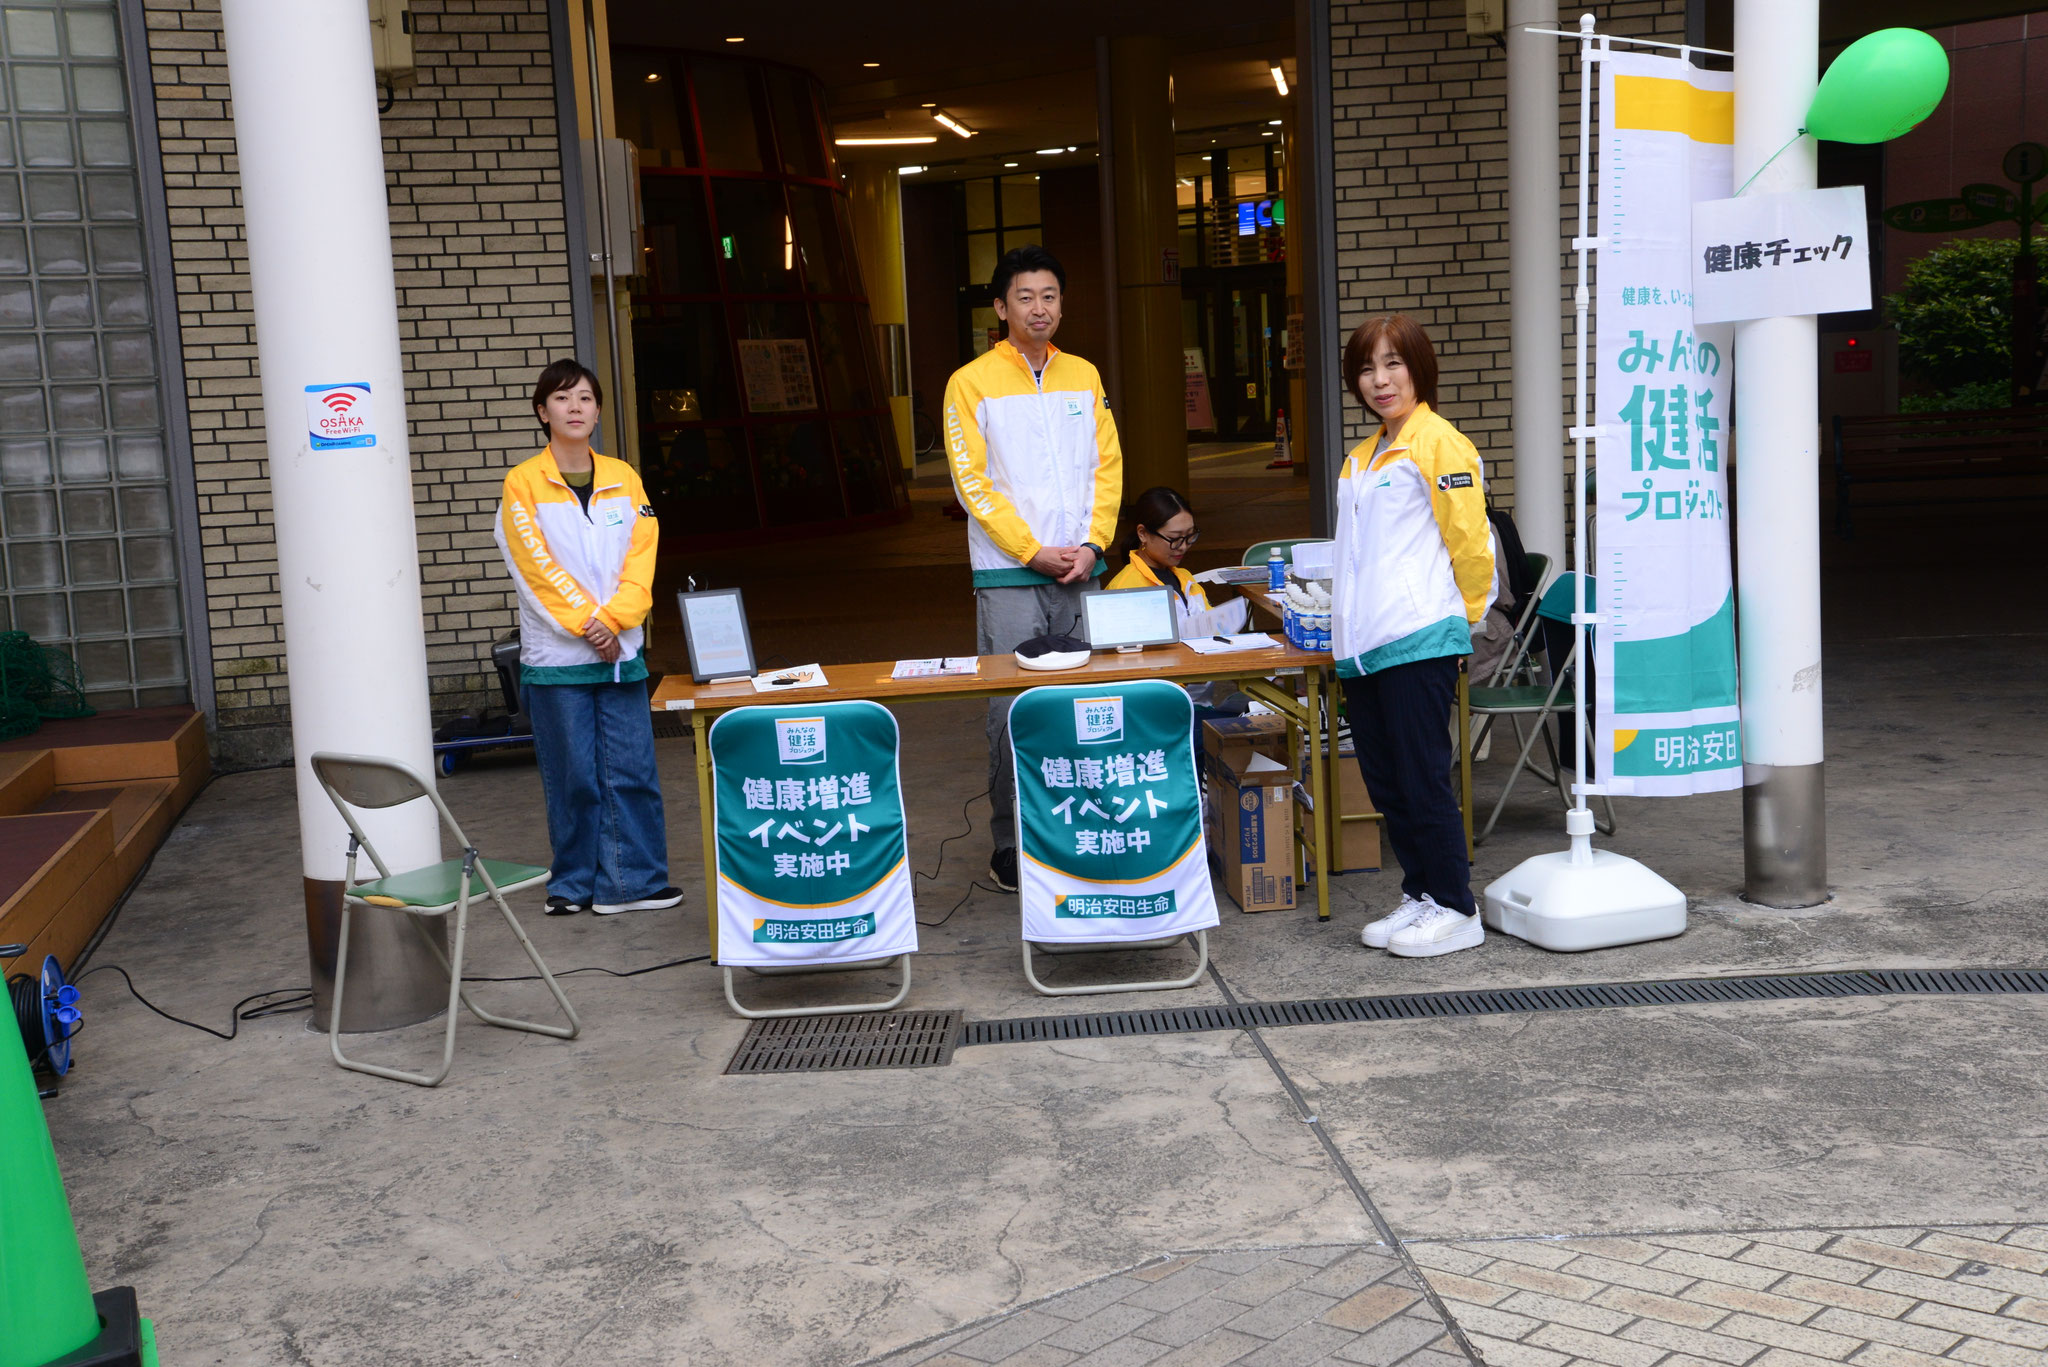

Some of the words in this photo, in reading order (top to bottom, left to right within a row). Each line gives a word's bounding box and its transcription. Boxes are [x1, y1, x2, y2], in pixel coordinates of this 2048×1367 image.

[1703, 234, 1854, 274] 健康チェック
[320, 414, 364, 428] OSAKA
[1618, 384, 1720, 472] 健活
[1622, 478, 1723, 521] プロジェクト
[510, 501, 552, 570] YASUDA
[545, 567, 587, 609] MEIJI
[1085, 705, 1115, 714] みんなの
[1086, 713, 1114, 726] 健活
[786, 726, 816, 734] みんなの
[788, 734, 816, 747] 健活
[1040, 749, 1169, 790] 健康増進
[742, 772, 872, 811] 健康増進
[1051, 789, 1168, 824] イベント
[748, 813, 871, 848] イベント
[1075, 827, 1151, 856] 実施中
[773, 850, 850, 878] 実施中
[1068, 895, 1169, 916] 明治安田生命
[766, 918, 868, 940] 明治安田生命
